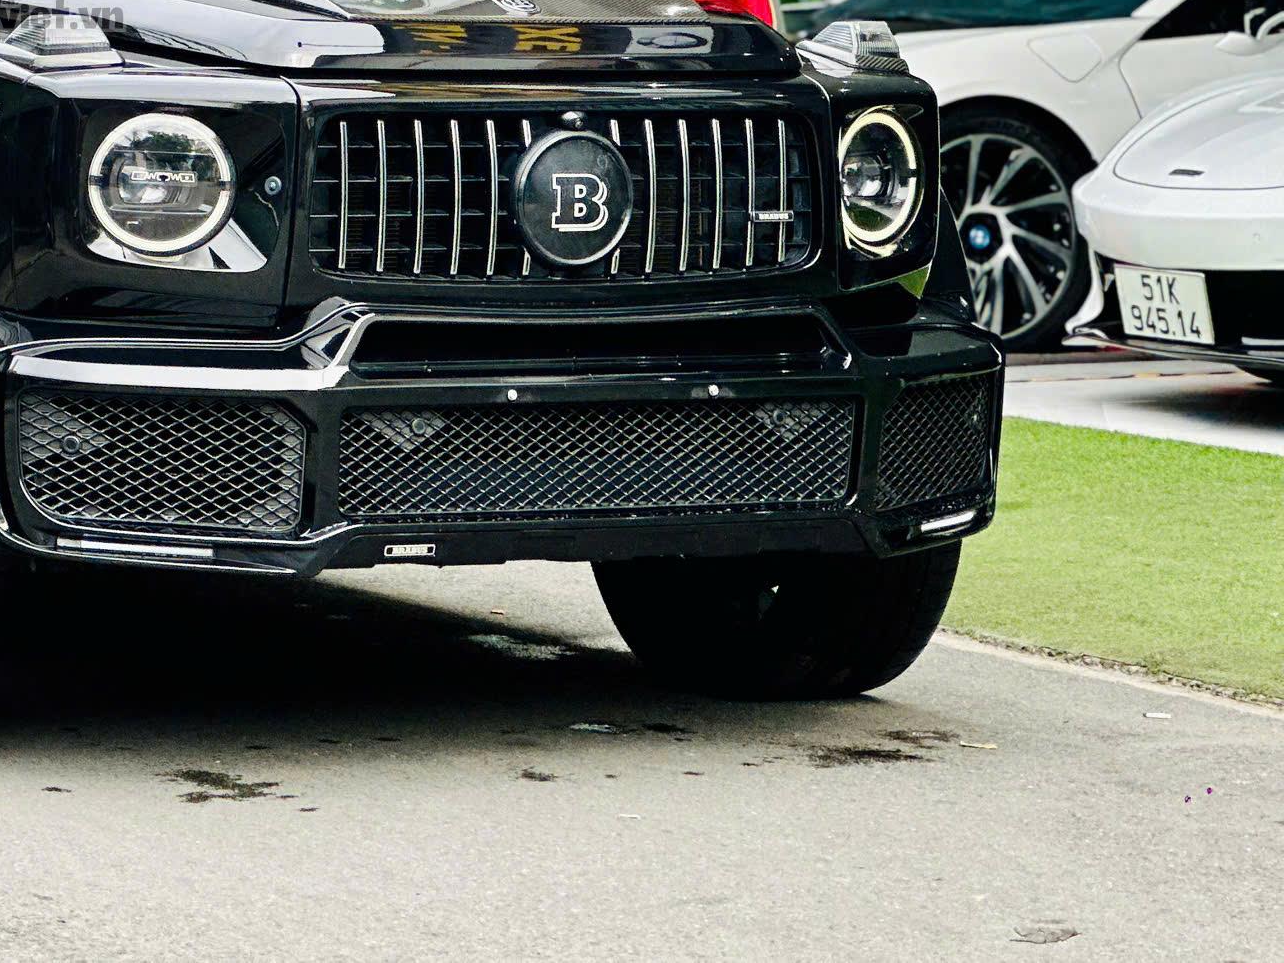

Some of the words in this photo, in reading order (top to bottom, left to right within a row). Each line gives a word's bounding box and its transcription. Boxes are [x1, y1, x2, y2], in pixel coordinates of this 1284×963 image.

[551, 173, 609, 232] B
[1140, 274, 1181, 305] 51K
[1131, 305, 1202, 338] 945.14
